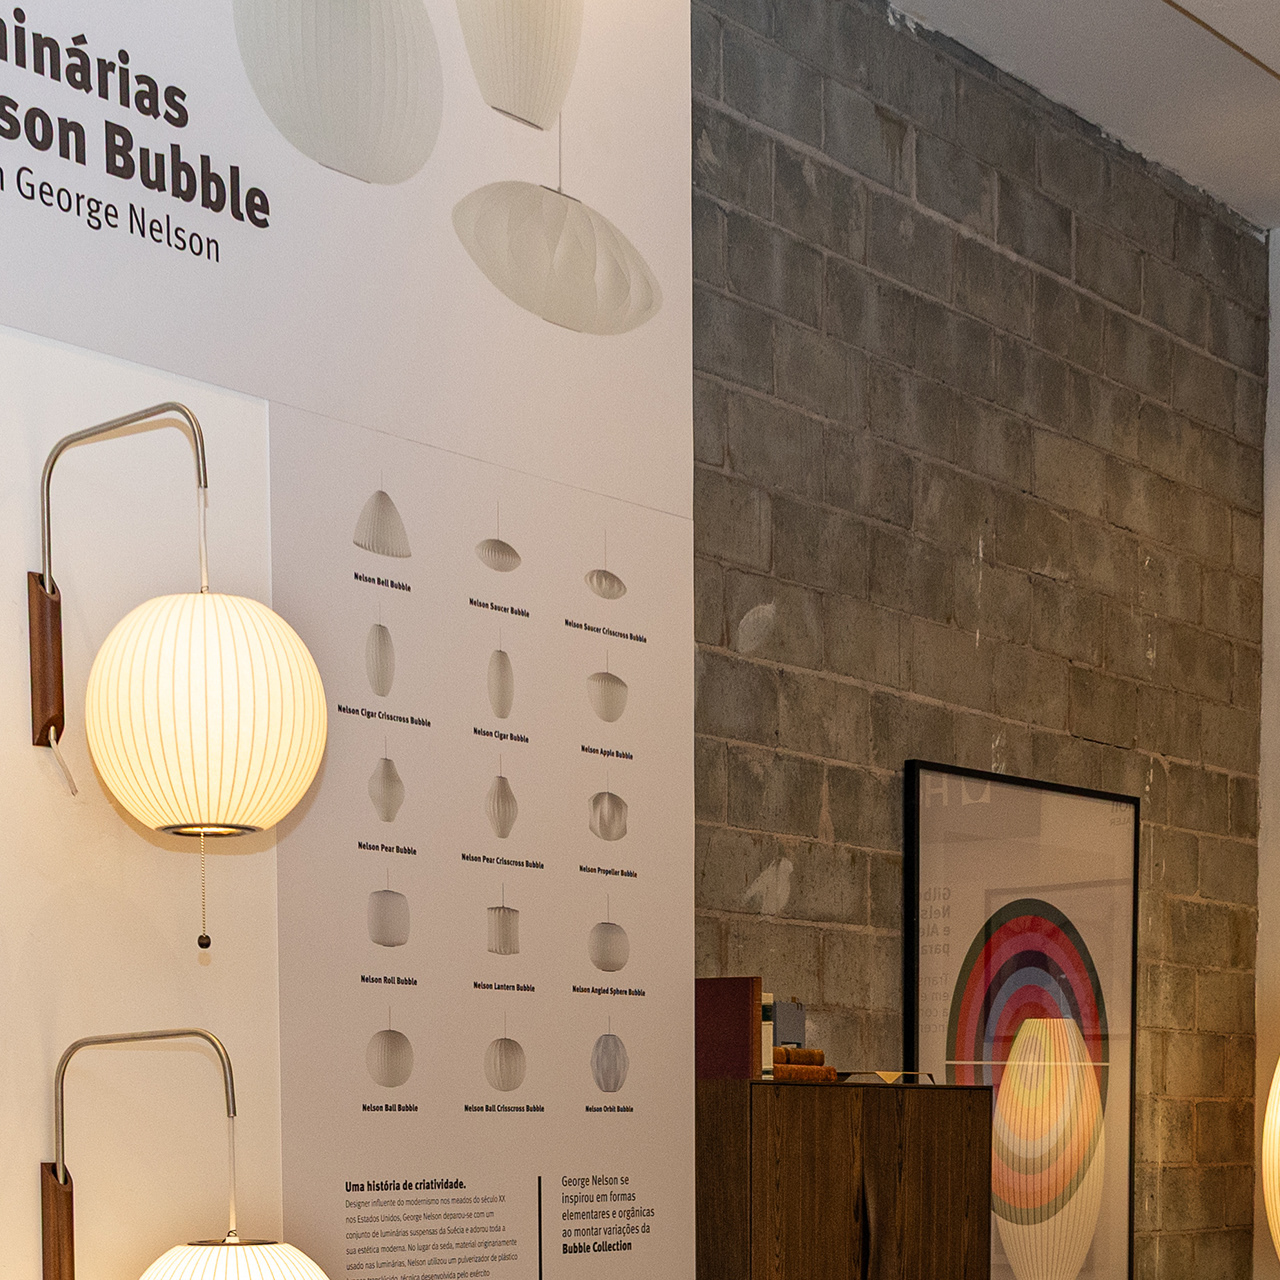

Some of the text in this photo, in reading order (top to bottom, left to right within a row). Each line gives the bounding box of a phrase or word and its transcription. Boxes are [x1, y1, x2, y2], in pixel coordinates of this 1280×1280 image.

[105, 120, 269, 229] Bubble
[17, 167, 118, 230] George
[129, 203, 219, 263] Nelson
[354, 572, 412, 592] Nelson Bell Bubble
[470, 598, 530, 618] Nelson Saucer Bubble
[565, 619, 647, 643] Nelson Saucer Crisscross Bubble
[338, 705, 432, 727] Nelson Cigar Crisscross Bubble
[474, 728, 529, 743] Nelson Cigar Bubble
[581, 745, 634, 760] Nelson Apple Bubble
[358, 841, 417, 855] Nelson Pear Bubble
[462, 853, 545, 869] Nelson Pear Crisscross Bubble
[579, 865, 638, 878] Nelson Propeller Bubble
[361, 975, 418, 985] Nelson Roll Bubble
[474, 981, 493, 989] Nelson
[516, 984, 536, 992] Bubble
[591, 986, 609, 995] Angled
[610, 987, 628, 996] Sphere
[398, 1104, 419, 1112] Bubble
[465, 1104, 485, 1112] Nelson
[346, 1179, 466, 1192] Uma história de criatividade.
[562, 1174, 629, 1189] George Nelson se
[562, 1191, 636, 1206] inspirou em formas
[562, 1206, 654, 1221] elementares e orgânicas
[562, 1223, 650, 1238] ao montar variações da
[562, 1240, 631, 1254] Bubble Collection
